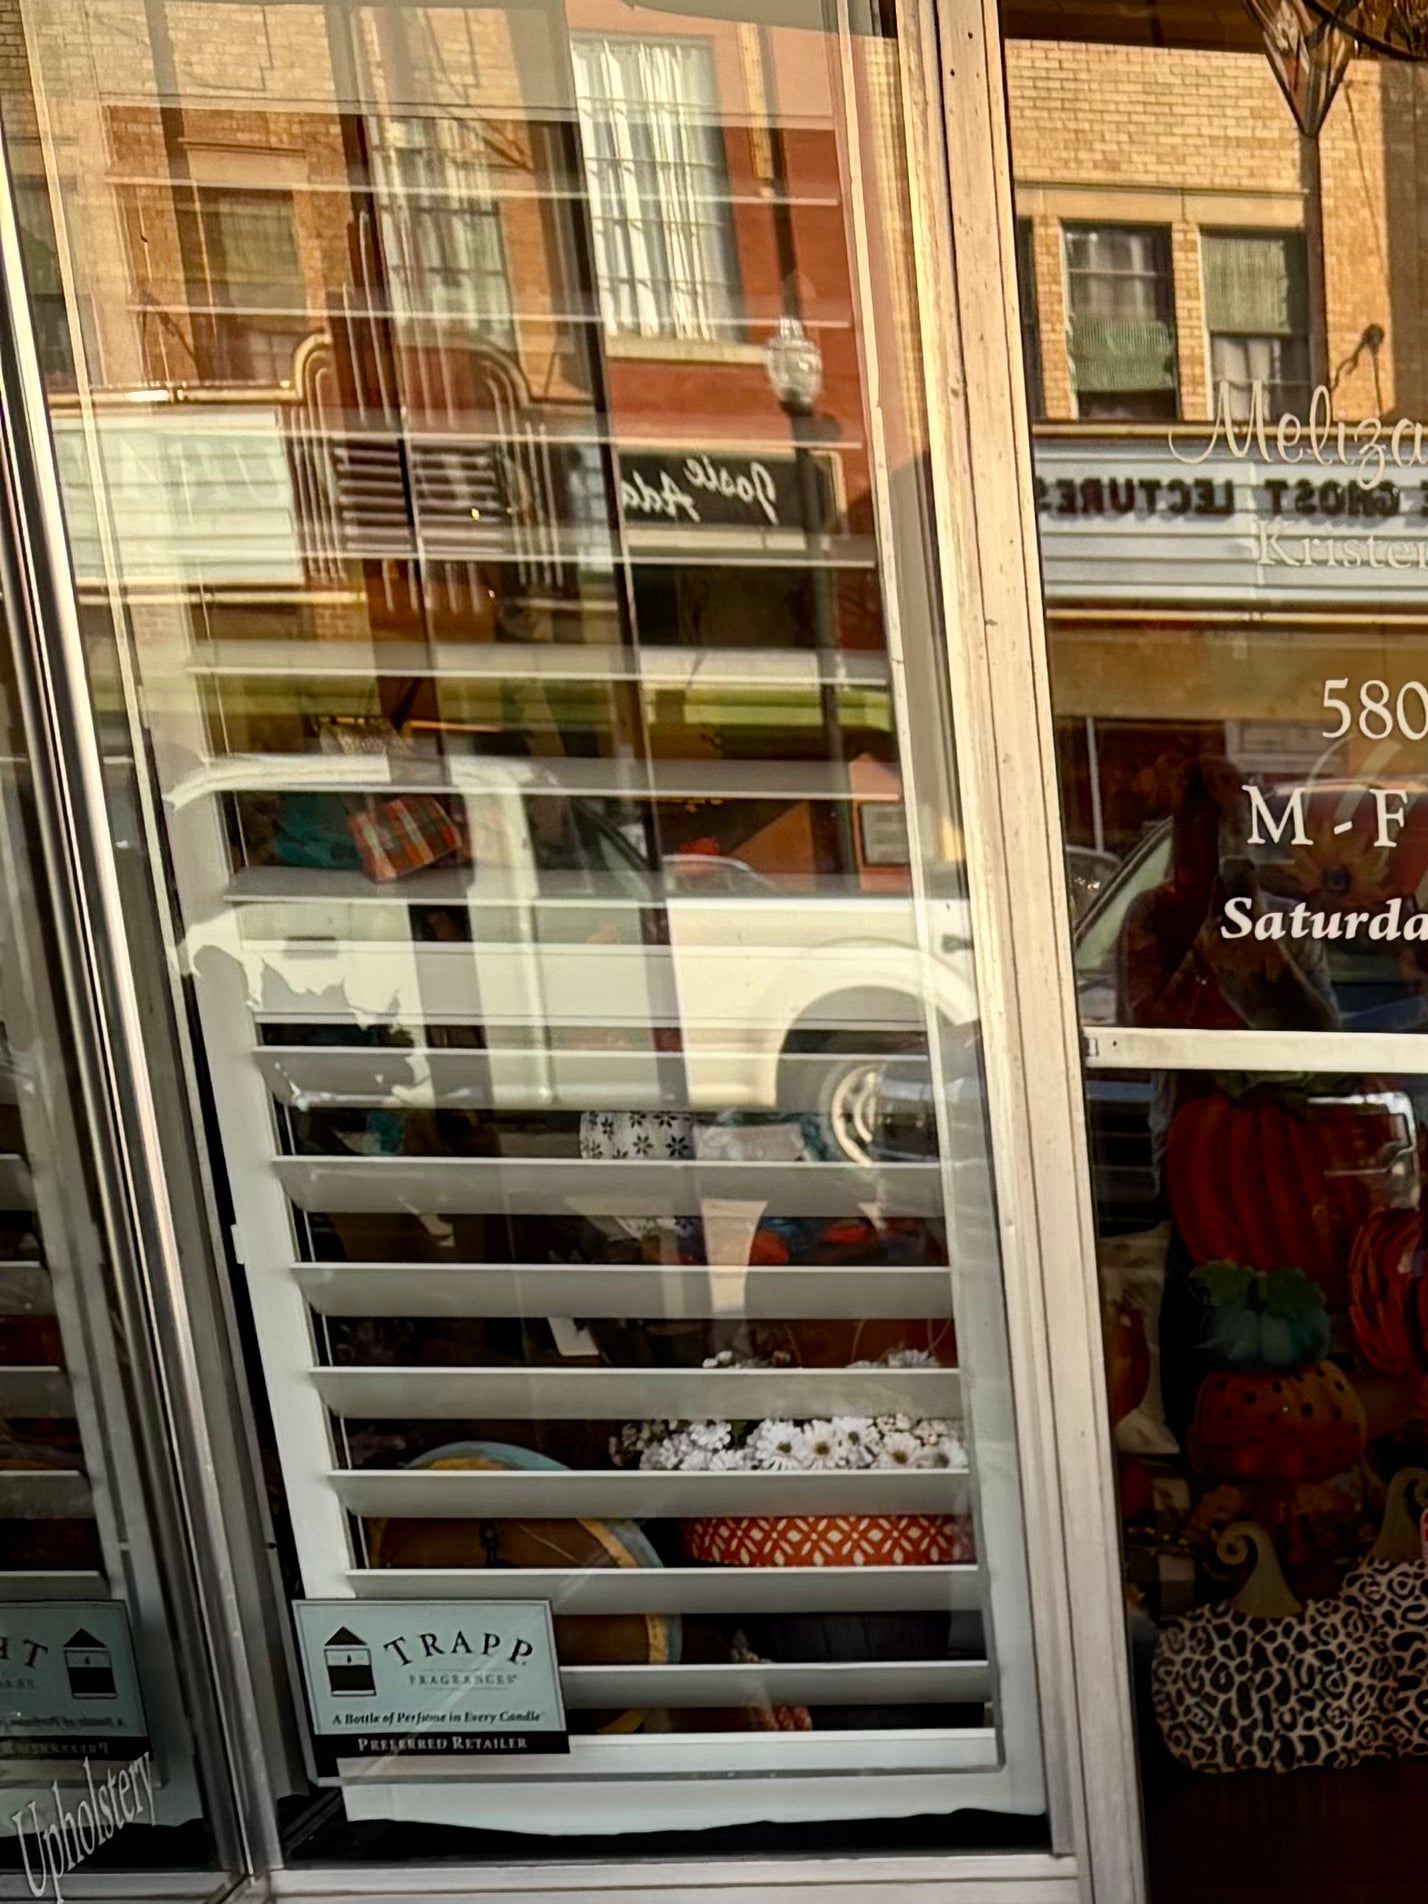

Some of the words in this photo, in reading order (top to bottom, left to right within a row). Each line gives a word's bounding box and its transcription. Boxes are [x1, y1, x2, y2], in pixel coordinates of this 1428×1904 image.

[1169, 379, 1428, 490] Meliza
[1242, 784, 1314, 846] M
[1370, 788, 1408, 849] F
[383, 1629, 534, 1667] TRAPP
[332, 1714, 342, 1725] A
[345, 1712, 380, 1725] Bottle
[382, 1711, 396, 1726] of
[396, 1712, 446, 1726] Perfume
[449, 1712, 462, 1723] in
[464, 1711, 497, 1724] Every
[499, 1710, 541, 1722] Candle
